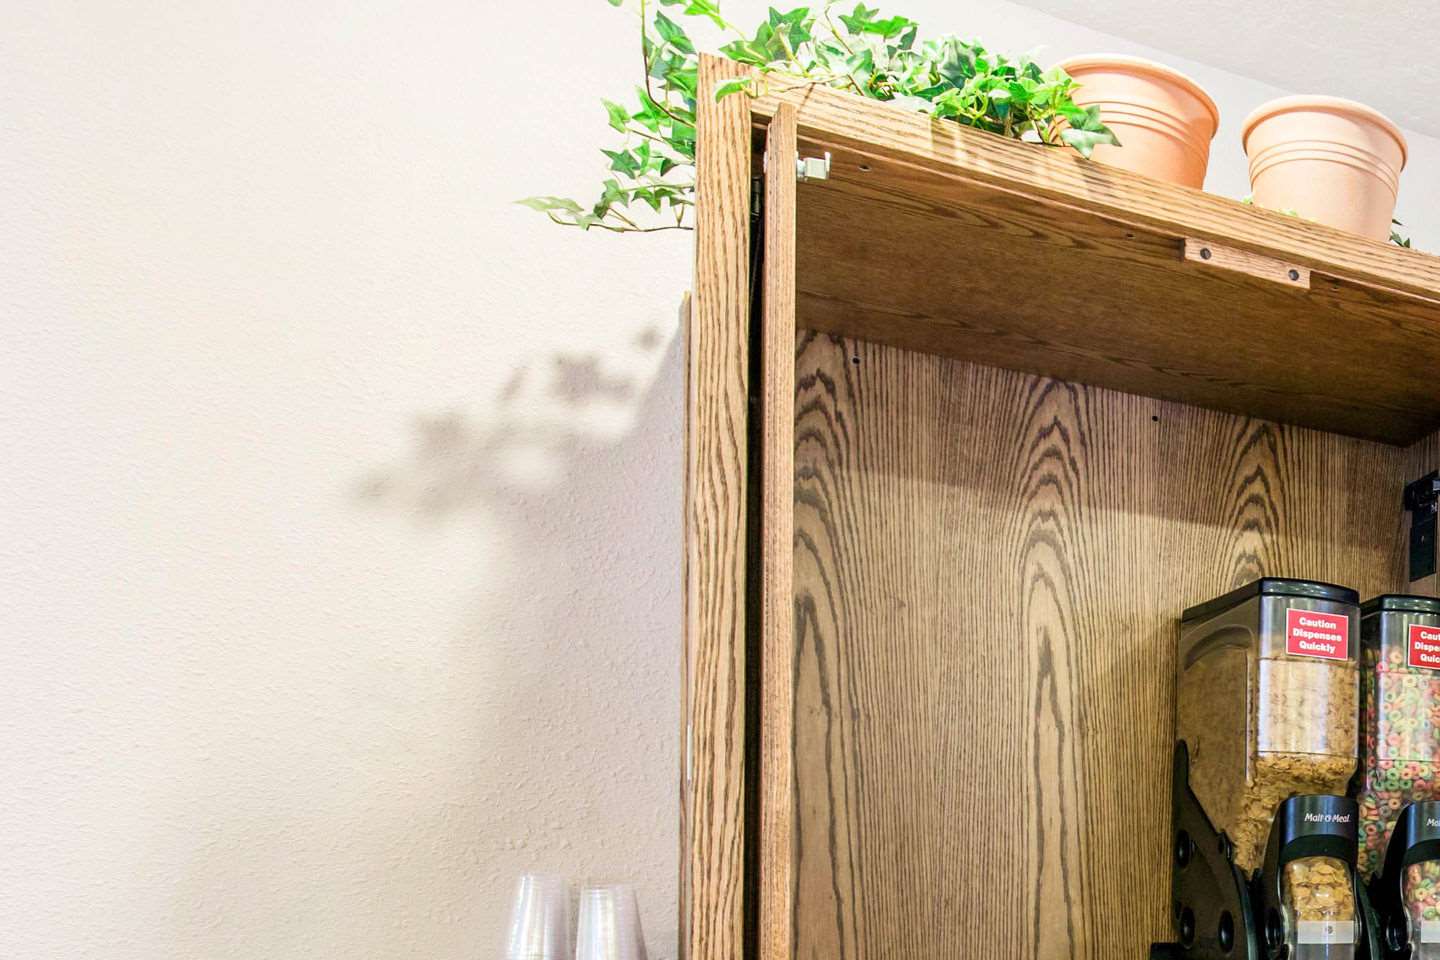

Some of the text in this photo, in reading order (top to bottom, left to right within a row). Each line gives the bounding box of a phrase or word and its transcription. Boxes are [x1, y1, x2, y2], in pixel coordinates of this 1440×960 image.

[1299, 617, 1337, 630] Caution
[1293, 628, 1342, 642] Dispenses
[1299, 641, 1336, 654] Quickly
